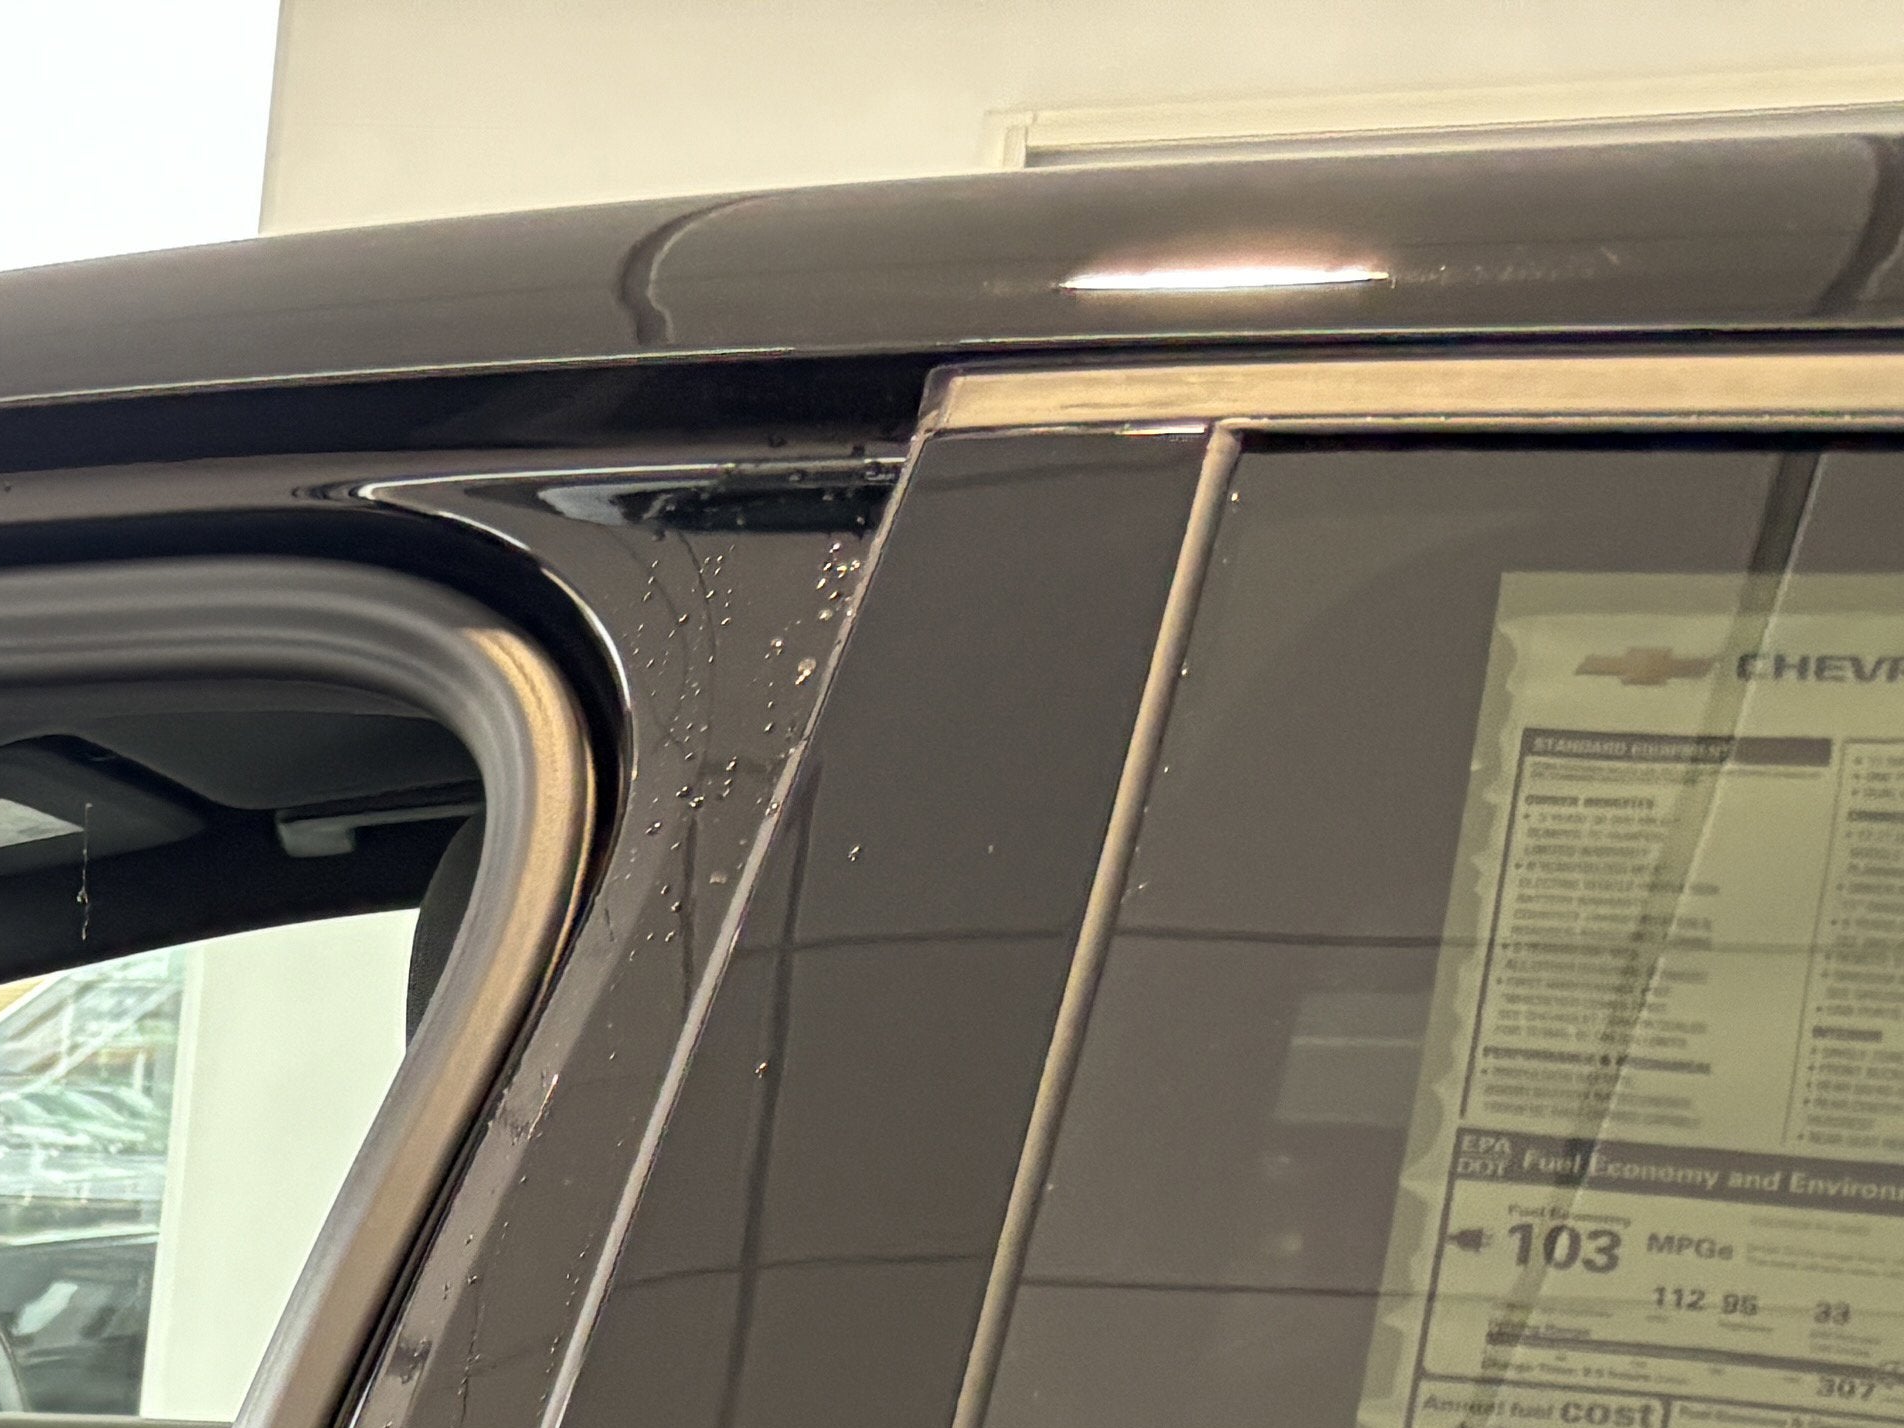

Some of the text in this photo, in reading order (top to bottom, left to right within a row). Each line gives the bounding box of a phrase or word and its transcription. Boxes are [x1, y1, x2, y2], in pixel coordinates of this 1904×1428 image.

[1461, 1134, 1513, 1155] EPA
[1456, 1157, 1513, 1177] DOT
[1523, 1147, 1582, 1174] Fuel
[1590, 1151, 1720, 1191] Economy
[1727, 1170, 1782, 1192] and
[1507, 1222, 1623, 1274] 103
[1646, 1232, 1734, 1261] MPGe
[1654, 1286, 1707, 1312] 112
